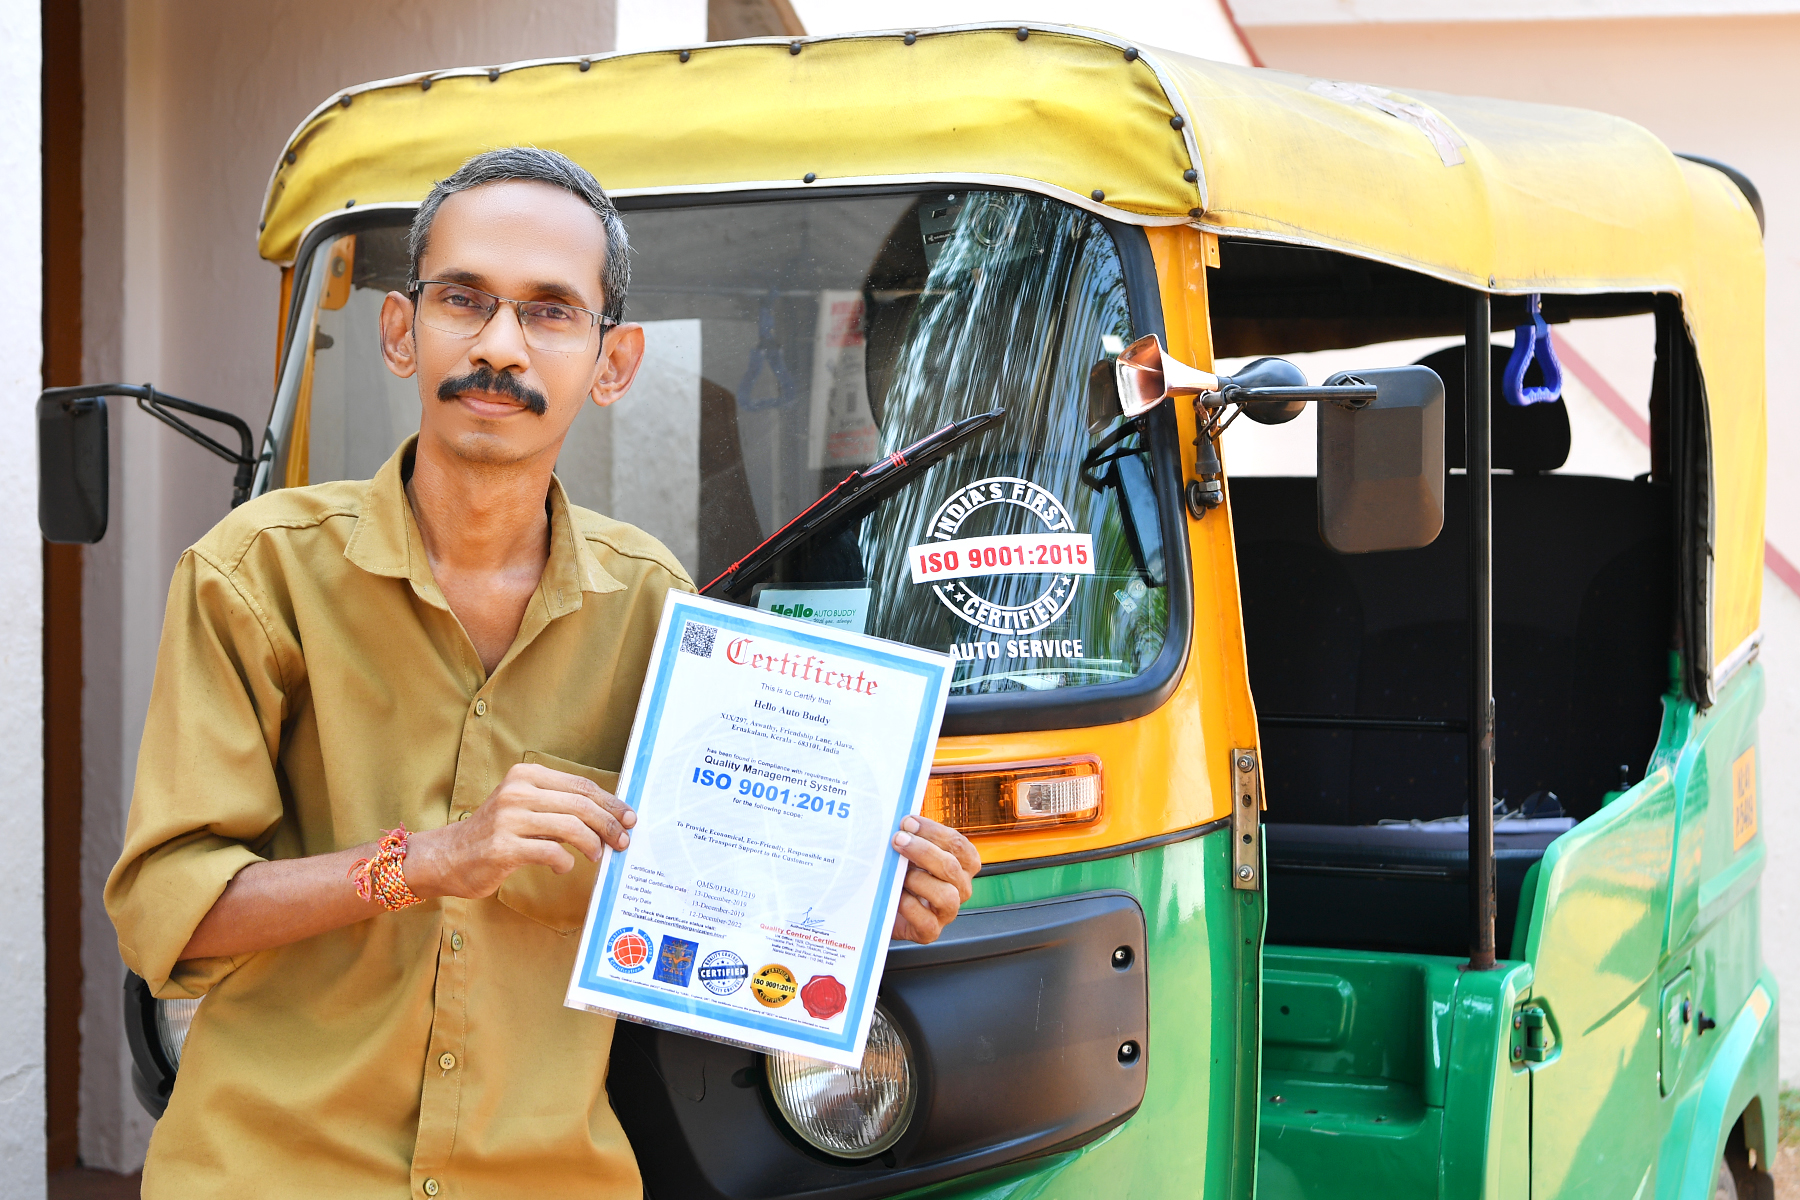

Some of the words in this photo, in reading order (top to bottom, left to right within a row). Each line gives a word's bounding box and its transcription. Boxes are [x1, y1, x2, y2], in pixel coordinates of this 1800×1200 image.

[934, 483, 1003, 540] INDIA'S
[1012, 484, 1068, 531] FIRST
[920, 550, 959, 574] ISO
[968, 544, 1088, 569] 9001:2015
[770, 604, 814, 618] Hello
[834, 609, 856, 617] BUDDY
[962, 596, 1059, 629] CERTIFIED
[950, 641, 1000, 661] AUTO
[1006, 638, 1084, 658] SERVICE
[726, 637, 878, 696] Certificate
[761, 683, 775, 692] This
[794, 691, 816, 702] Certify
[754, 700, 776, 711] Hello
[779, 706, 800, 717] Auto
[802, 711, 830, 726] Buddy
[770, 733, 791, 743] Kerala
[823, 746, 839, 754] India
[780, 727, 813, 741] Friendship
[705, 755, 740, 772] Quality
[743, 764, 807, 786] Management
[809, 780, 846, 796] System
[734, 754, 750, 762] found
[758, 760, 790, 771] Compliance
[804, 772, 840, 783] requirements
[692, 767, 731, 790] ISO
[739, 779, 850, 818] 9001:2015
[754, 802, 781, 814] following
[685, 823, 708, 833] Provide
[787, 848, 822, 860] Responsible
[709, 837, 737, 848] Transport
[738, 844, 762, 854] Support
[782, 855, 813, 866] Customers
[630, 865, 655, 874] Certificate
[628, 874, 647, 883] Original
[648, 879, 673, 889] Certificate
[694, 890, 747, 907] 13-December-2019
[622, 893, 639, 902] Expiry
[689, 911, 741, 928] 12-December-2022
[692, 900, 744, 917] 13-December-2019
[608, 928, 626, 947] Quality
[643, 934, 654, 958] Control
[760, 924, 784, 934] Quality
[786, 929, 811, 940] Control
[813, 936, 855, 950] Certification
[610, 960, 642, 974] Certification
[700, 966, 746, 978] CERTIFIED
[764, 967, 789, 980] CERTIFIED
[752, 978, 764, 986] ISO
[765, 979, 796, 993] 9001:2015
